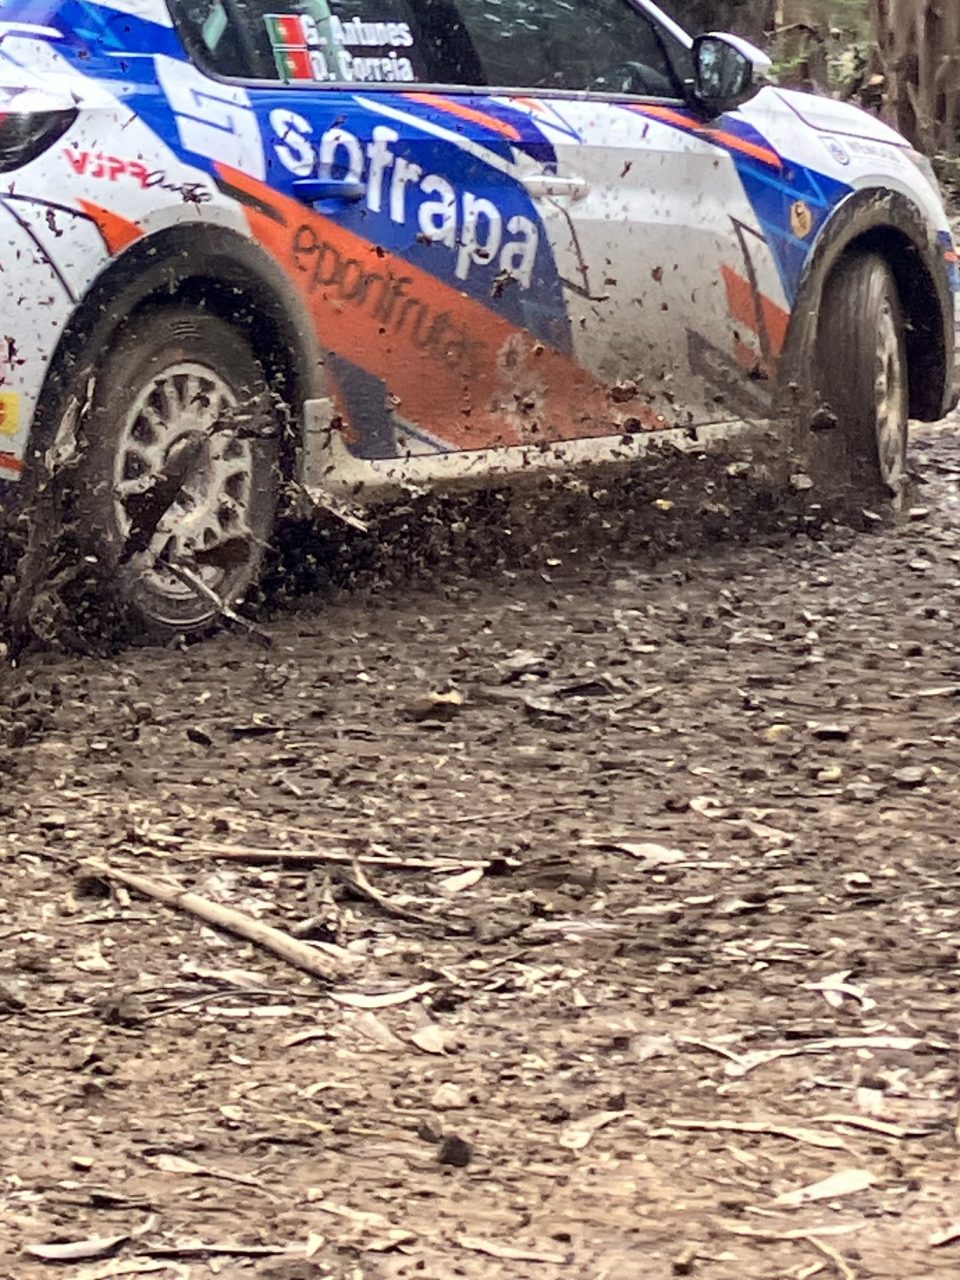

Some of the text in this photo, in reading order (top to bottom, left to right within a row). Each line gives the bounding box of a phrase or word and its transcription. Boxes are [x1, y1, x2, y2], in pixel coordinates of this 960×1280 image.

[329, 15, 414, 47] Antunes
[337, 50, 415, 81] Correia
[269, 107, 538, 291] sofrapa
